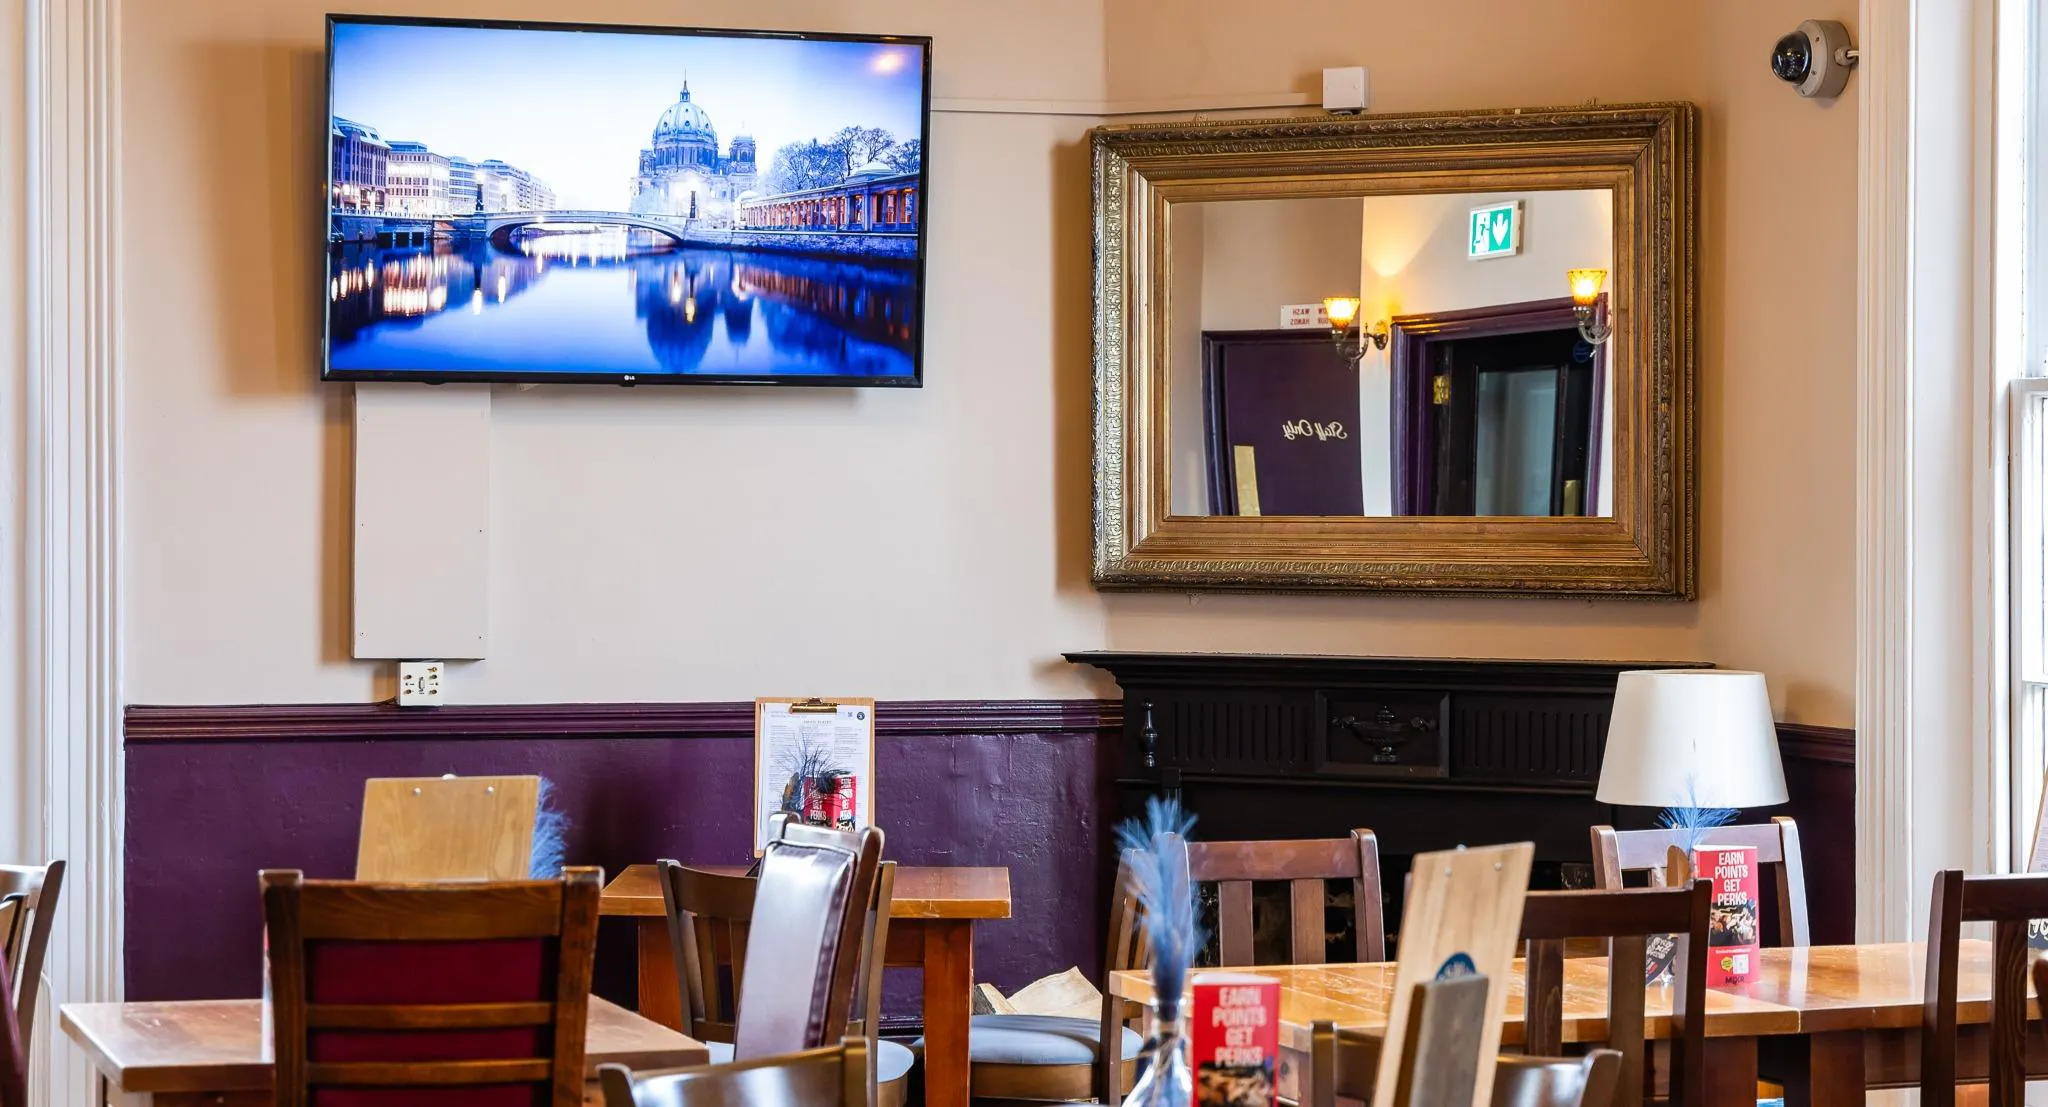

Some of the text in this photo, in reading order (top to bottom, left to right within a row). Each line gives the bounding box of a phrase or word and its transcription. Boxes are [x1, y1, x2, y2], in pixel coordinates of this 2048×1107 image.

[809, 810, 827, 821] PERKS
[1718, 851, 1744, 866] EARN
[1714, 866, 1748, 879] POINTS
[1723, 879, 1741, 892] GET
[1717, 892, 1748, 907] PERKS
[1219, 986, 1262, 1006] EARN
[1212, 1005, 1267, 1028] POINTS
[1225, 1026, 1254, 1047] GET
[1214, 1046, 1264, 1067] PERKS
